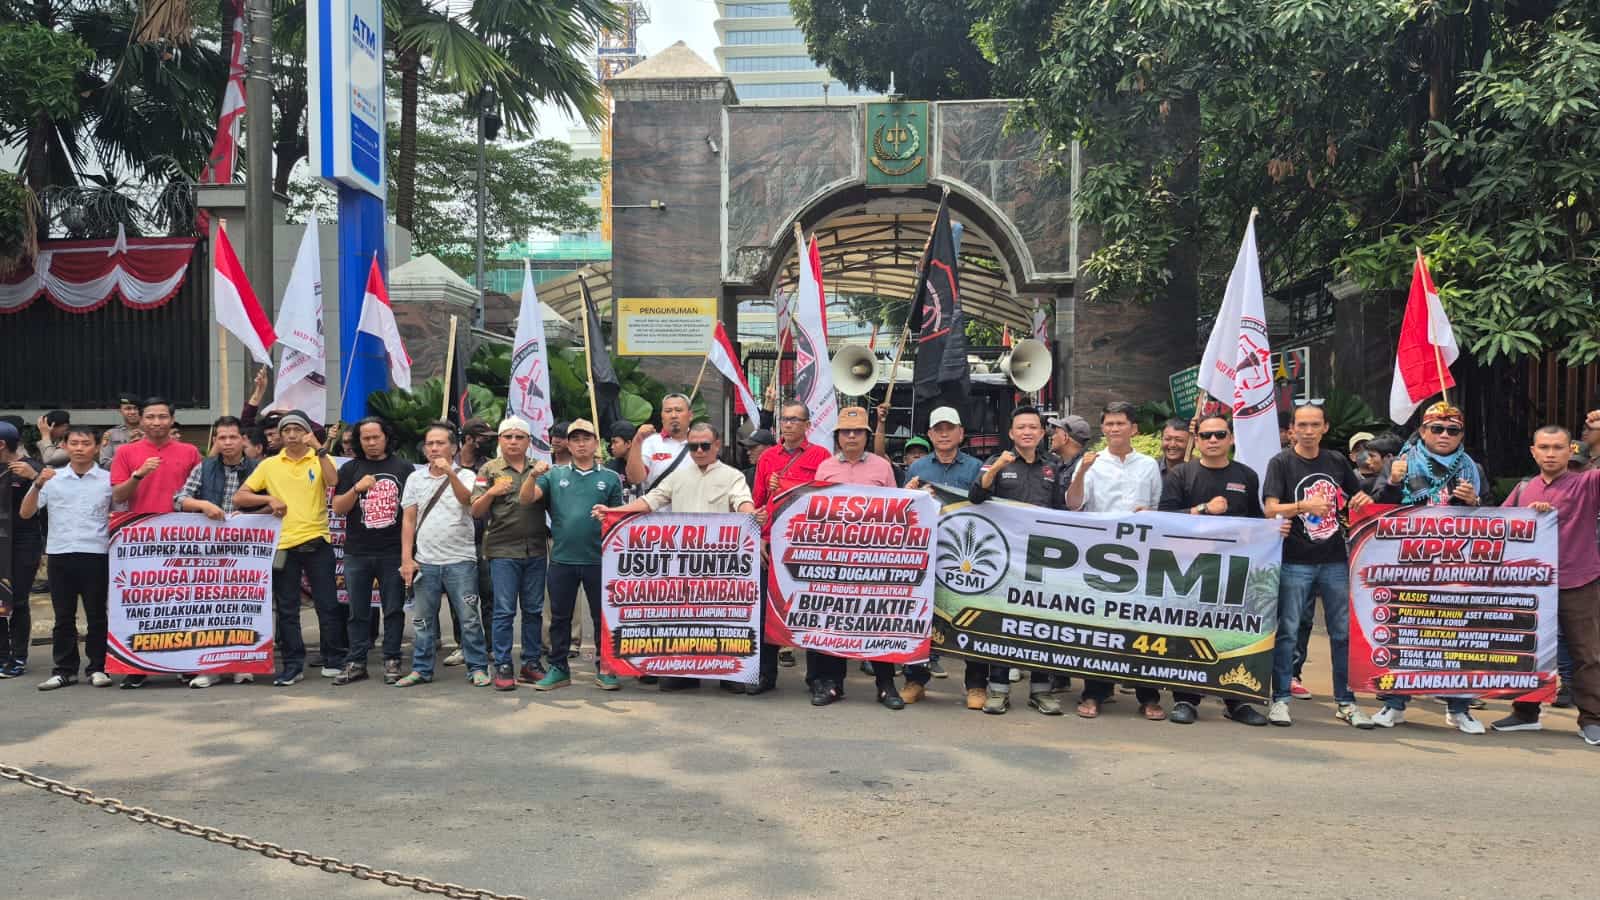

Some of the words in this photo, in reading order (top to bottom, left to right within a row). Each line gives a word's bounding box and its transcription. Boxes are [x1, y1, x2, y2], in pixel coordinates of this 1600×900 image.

[353, 14, 376, 51] ATM
[639, 306, 699, 315] PENGUMUMAN
[806, 495, 912, 525] DESAK
[121, 526, 156, 543] TATA
[160, 526, 211, 542] KELOLA
[214, 527, 275, 544] KEGIATAN
[629, 525, 680, 550] KPK
[791, 522, 904, 547] KEJAGUNG
[907, 527, 931, 547] RI
[1115, 522, 1153, 542] PT
[1376, 517, 1505, 539] KEJAGUNG
[1509, 519, 1536, 541] RI
[117, 547, 126, 558] DI
[129, 545, 177, 558] DLHPPKP
[179, 545, 201, 556] KAB.
[205, 545, 249, 556] LAMPUNG
[791, 549, 823, 561] AMBIL
[826, 550, 849, 562] ALIH
[851, 551, 923, 565] PENANGANAN
[1399, 539, 1468, 561] KPK
[1470, 540, 1505, 562] RI
[618, 553, 672, 574] USUT
[677, 553, 752, 575] TUNTAS
[1023, 533, 1250, 607] PSMI
[130, 570, 189, 587] DIDUGA
[191, 569, 220, 584] JADI
[223, 569, 261, 583] LAHAN
[798, 565, 837, 580] KASUS
[838, 567, 887, 582] DUGAAN
[889, 569, 918, 583] TPPU
[945, 572, 985, 589] PSMI
[1367, 567, 1430, 582] LAMPUNG
[1433, 566, 1490, 582] DARURAT
[1492, 566, 1550, 581] KORUPSI
[194, 586, 265, 601] BESAR2RAN
[614, 580, 685, 603] SKANDAL
[688, 579, 756, 603] TAMBANG
[811, 583, 831, 593] YANG
[831, 584, 859, 594] DIDUGA
[861, 585, 909, 596] MELIBATKAN
[798, 594, 862, 614] BUPATI
[863, 598, 917, 616] AKTIF
[1398, 592, 1428, 602] KASUS
[1499, 596, 1534, 606] LAMPUNG
[126, 605, 151, 619] YANG
[154, 604, 212, 618] DILAKUKAN
[215, 603, 239, 614] OLEH
[623, 608, 642, 618] YANG
[643, 607, 670, 618] TERJADI
[671, 608, 678, 617] DI
[695, 607, 726, 618] LAMPUNG
[728, 607, 748, 618] TIMUR
[1007, 587, 1096, 616] DALANG
[1104, 600, 1263, 634] PERAMBAHAN
[1398, 608, 1435, 617] PULUHAN
[1437, 609, 1463, 618] TAHUN
[1464, 610, 1483, 620] ASET
[1483, 611, 1514, 621] NEGARA
[138, 618, 182, 631] PEJABAT
[185, 617, 205, 628] DAN
[208, 616, 241, 627] KOLEGA
[787, 612, 822, 628] KAB.
[825, 615, 926, 634] PESAWARAN
[1398, 616, 1416, 625] JADI
[1417, 616, 1442, 625] LAHAN
[1443, 617, 1468, 627] KORUP
[133, 632, 193, 651] PERIKSA
[195, 631, 225, 647] DAN
[226, 630, 254, 645] ADILI
[621, 627, 650, 638] DIDUGA
[652, 627, 688, 637] LIBATKAN
[689, 627, 714, 637] ORANG
[715, 628, 750, 638] TERDEKAT
[1001, 617, 1126, 650] REGISTER
[1132, 634, 1168, 656] 44
[1398, 629, 1418, 637] YANG
[1419, 629, 1457, 639] LIBATKAN
[1457, 631, 1489, 640] MANTAN
[1490, 632, 1525, 642] PEJABAT
[620, 638, 662, 654] BUPATI
[665, 638, 718, 653] LAMPUNG
[719, 638, 752, 653] TIMUR
[802, 633, 863, 649] #ALAMBAKA
[865, 639, 907, 650] LAMPUNG
[1398, 637, 1440, 646] WAYKANAN
[1441, 638, 1458, 647] DAN
[1459, 639, 1470, 648] PT
[1470, 640, 1490, 649] PSMI
[646, 659, 696, 671] #ALAMBAKA
[697, 660, 735, 671] LAMPUNG
[973, 640, 1049, 663] KABUPATEN
[1052, 653, 1081, 668] WAY
[1083, 657, 1130, 674] KANAN
[1141, 665, 1208, 683] LAMPUNG
[1399, 650, 1423, 659] TEGAK
[1425, 650, 1442, 659] KAN
[1443, 651, 1488, 662] SUPREMASI
[1488, 653, 1518, 664] HUKUM
[1399, 658, 1444, 668] SEADIL-ADIL
[1445, 659, 1460, 669] NYA
[1378, 673, 1469, 690] #ALAMBAKA
[1472, 675, 1539, 689] LAMPUNG
